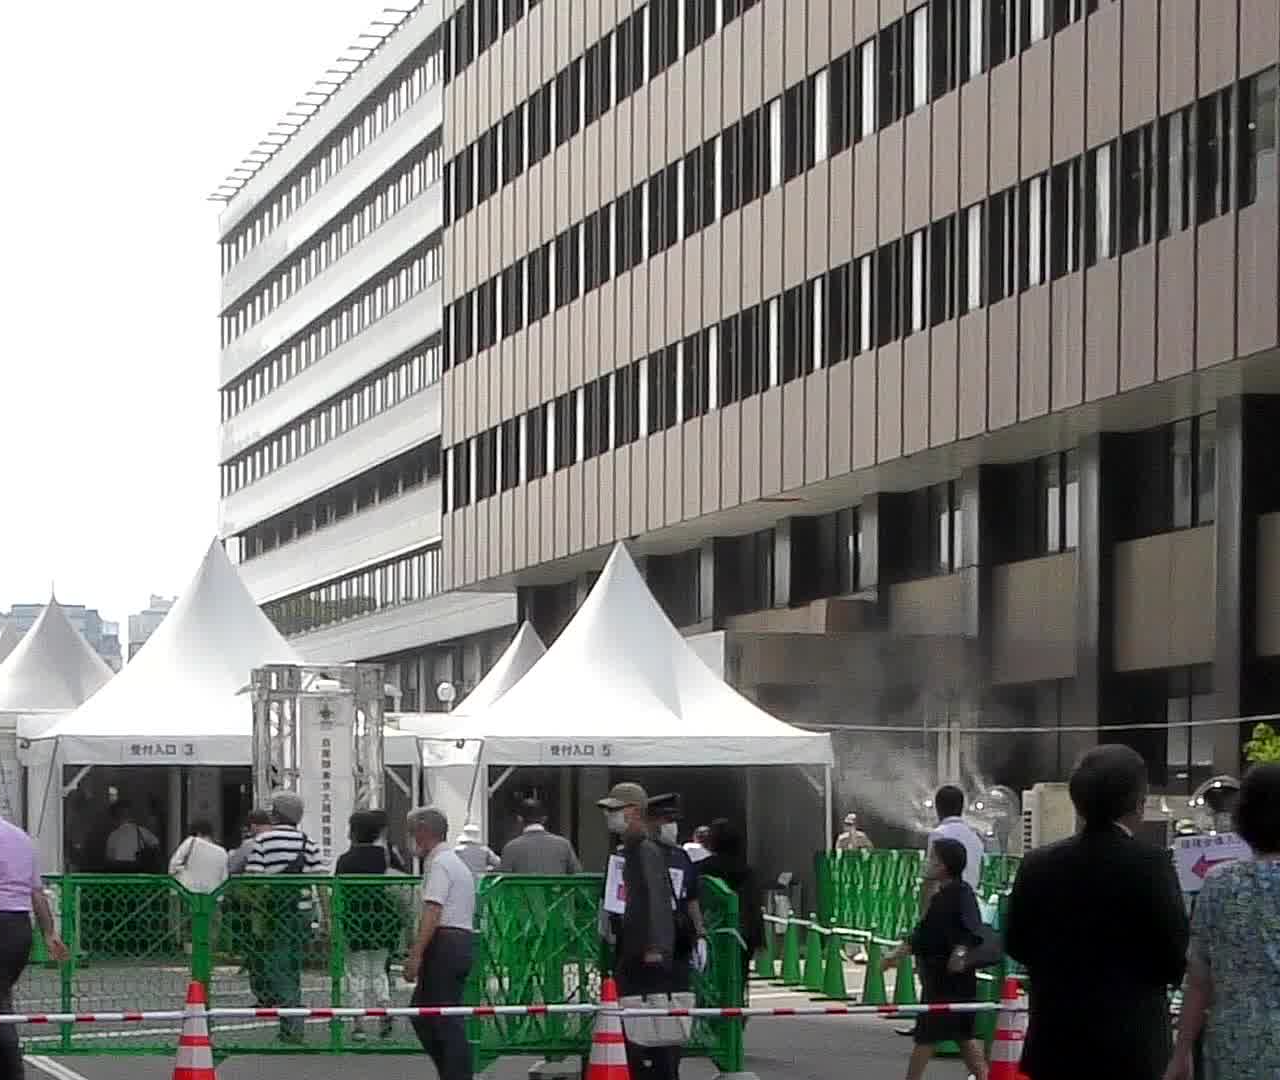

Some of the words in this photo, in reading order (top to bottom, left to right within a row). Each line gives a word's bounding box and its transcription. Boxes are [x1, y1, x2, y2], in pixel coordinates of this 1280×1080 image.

[131, 744, 176, 756] 受付入口
[184, 744, 195, 756] 3
[550, 744, 595, 757] 受付入口
[602, 744, 611, 757] 5
